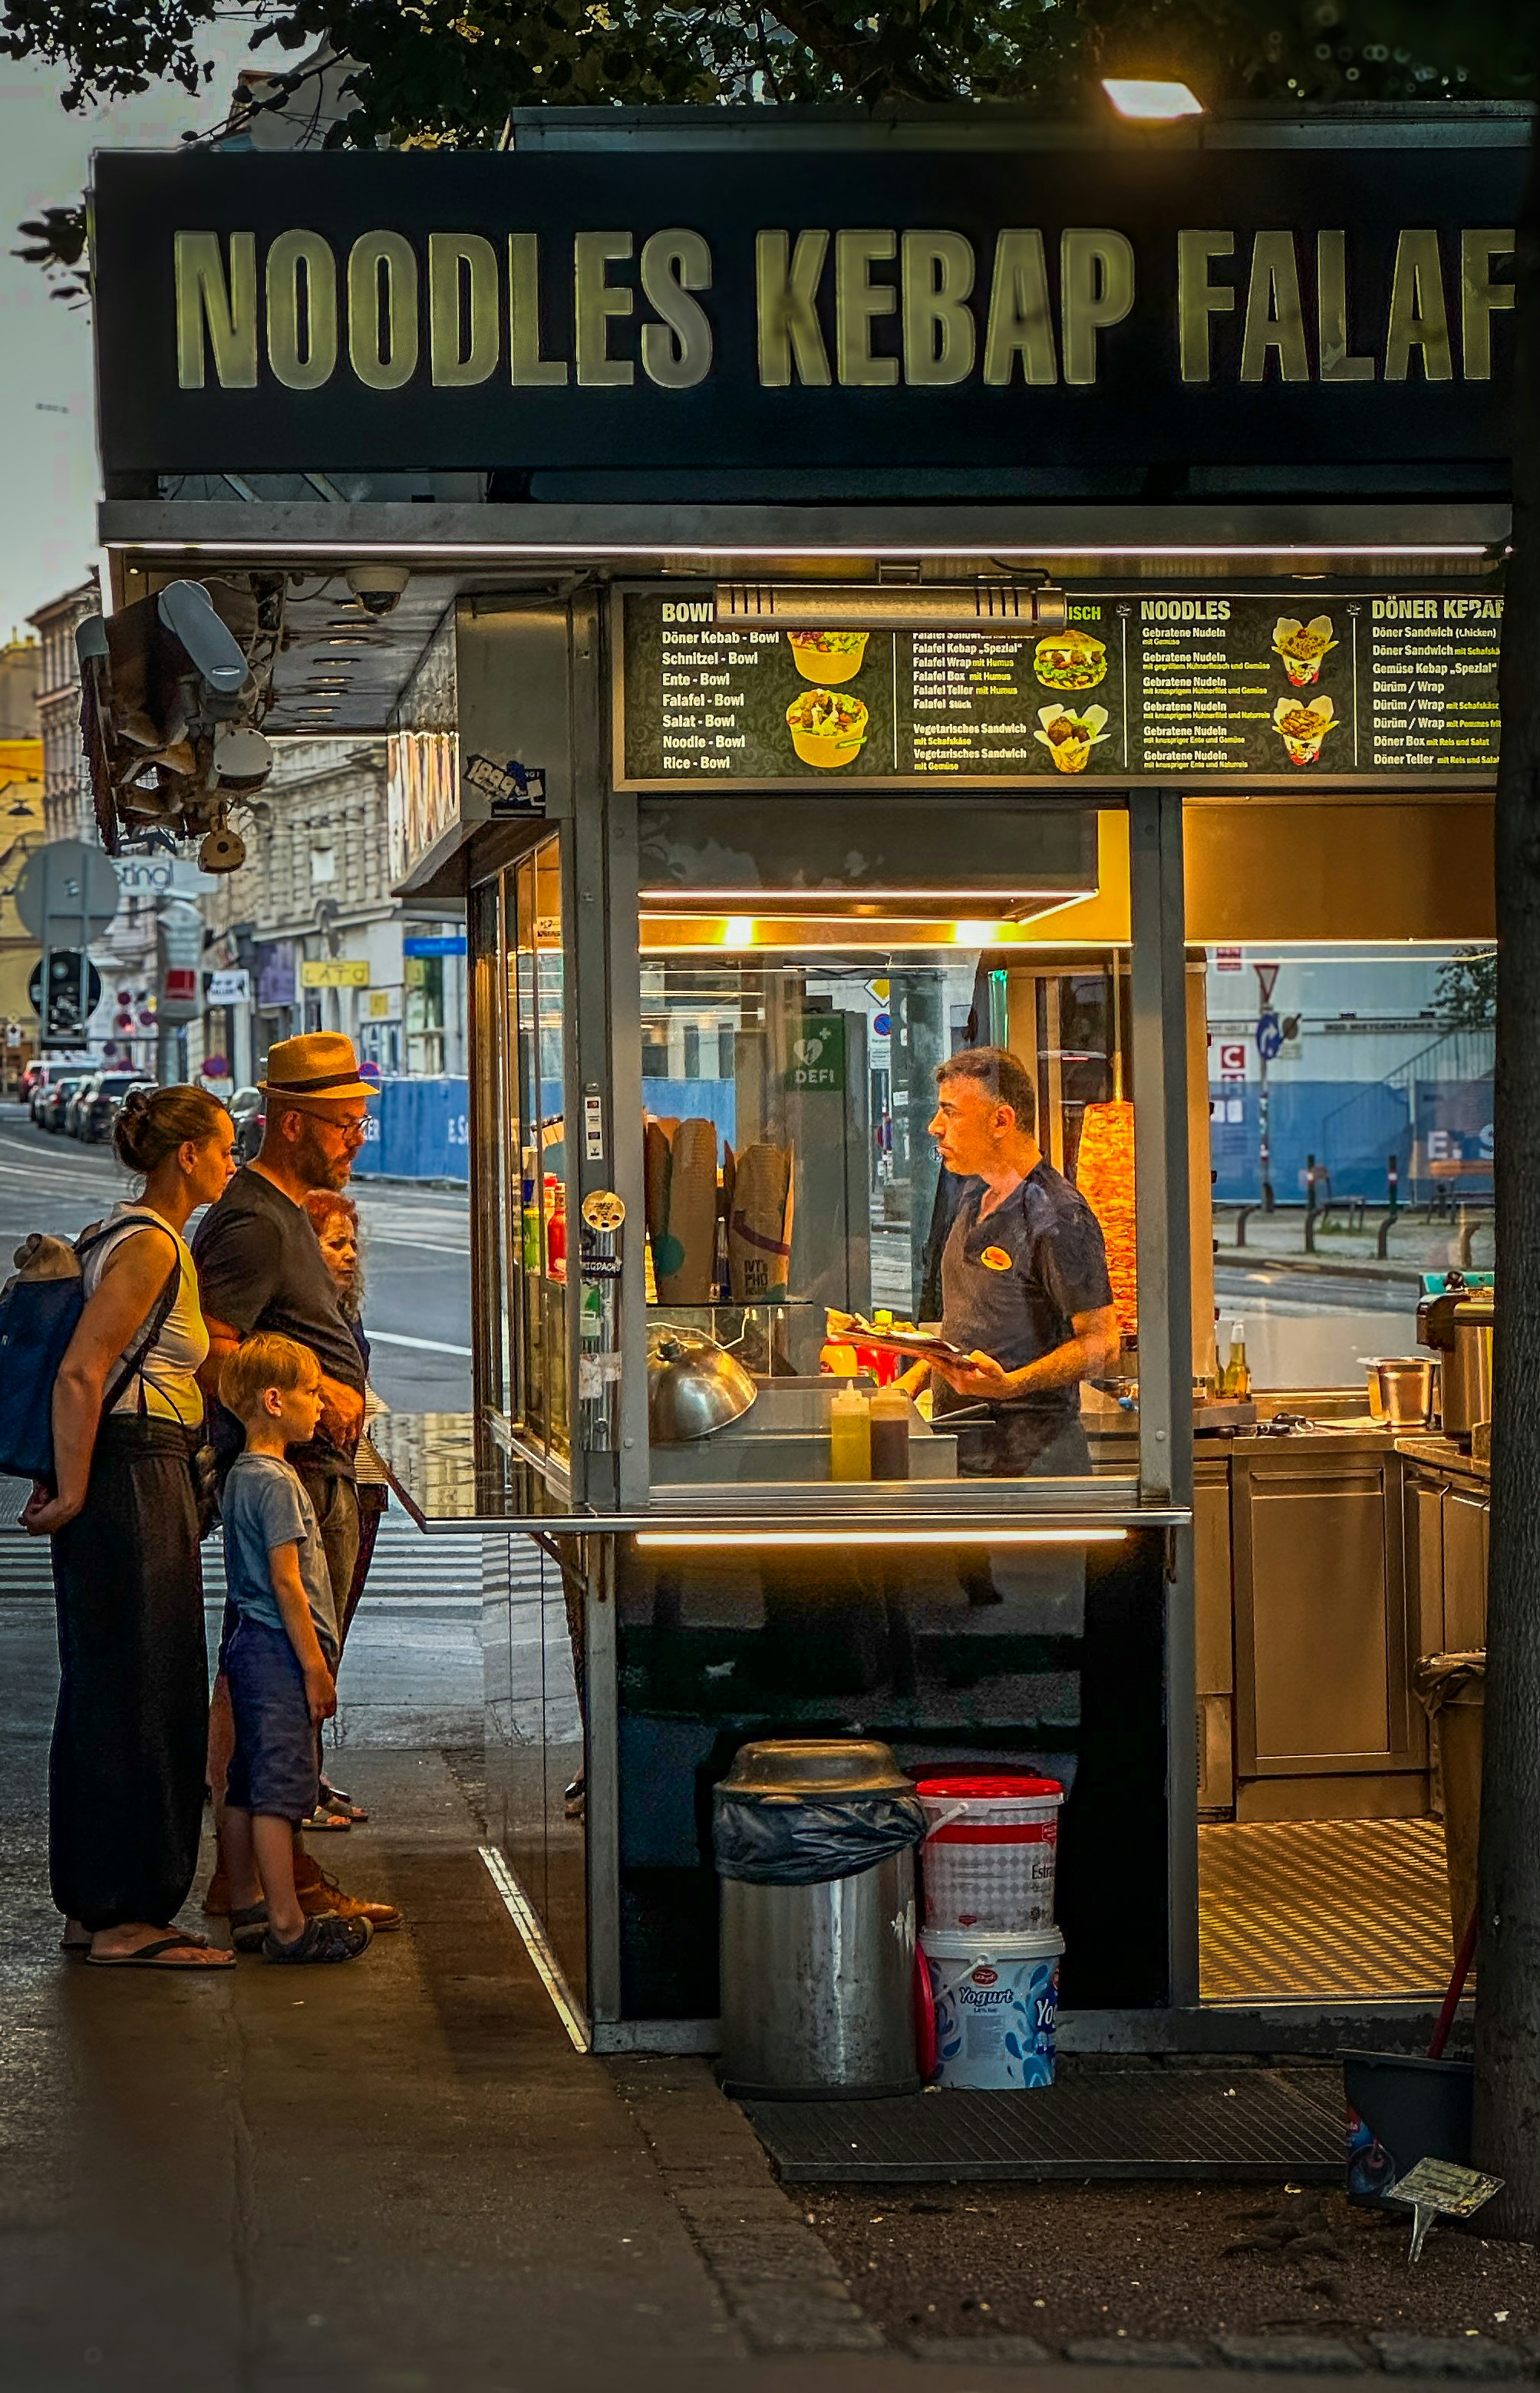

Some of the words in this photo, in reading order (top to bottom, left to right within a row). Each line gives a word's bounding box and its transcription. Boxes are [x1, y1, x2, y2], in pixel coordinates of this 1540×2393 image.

[174, 229, 714, 390] NOODLES
[755, 228, 1135, 386] KEBAP
[1140, 601, 1231, 620] NOODLES
[1372, 596, 1438, 619] DÖNER
[662, 631, 699, 644] Döner
[701, 631, 740, 644] Kebab
[750, 631, 779, 644] Bowl
[1142, 627, 1192, 638] Gebratene
[1192, 627, 1226, 638] Nudeln
[1372, 626, 1403, 638] Döner
[1404, 626, 1453, 638] Sandwich
[912, 642, 945, 653] Falafel
[947, 642, 977, 655] Kebap
[1372, 645, 1403, 655] Döner
[1404, 645, 1454, 655] Sandwich
[661, 652, 718, 665] Schnitzel
[729, 652, 758, 665] Bowl
[912, 657, 945, 667] Falafel
[947, 657, 972, 668] Wrap
[972, 658, 984, 667] mit
[1143, 652, 1192, 662] Gebratene
[1193, 652, 1226, 662] Nudeln
[1372, 662, 1414, 674] Gemüse
[1416, 662, 1448, 675] Kebap
[662, 672, 691, 686] Ente
[700, 672, 730, 686] Bowl
[913, 671, 945, 682] Falafel
[947, 671, 965, 682] Box
[969, 672, 982, 681] mit
[1143, 677, 1192, 687] Gebratene
[1193, 677, 1226, 687] Nudeln
[913, 685, 946, 695] Falafel
[947, 685, 974, 695] Teller
[975, 686, 989, 695] mit
[1373, 681, 1407, 692] Dürüm
[1408, 681, 1416, 694] /
[1417, 681, 1445, 694] Wrap
[662, 693, 705, 707] Falafel
[714, 693, 744, 707] Bowl
[913, 698, 946, 709] Falafel
[1143, 701, 1192, 711] Gebratene
[1193, 701, 1227, 711] Nudeln
[1373, 699, 1407, 711] Dürüm
[1408, 699, 1416, 712] /
[1417, 699, 1445, 712] Wrap
[662, 714, 696, 728] Salat
[705, 714, 735, 728] Bowl
[1373, 717, 1407, 728] Dürüm
[1408, 717, 1416, 730] /
[1417, 717, 1445, 730] Wrap
[913, 723, 980, 735] Vegetarisches
[981, 723, 1027, 734] Sandwich
[1143, 725, 1192, 736] Gebratene
[1194, 725, 1227, 736] Nudeln
[663, 735, 706, 748] Noodle
[715, 735, 745, 748] Bowl
[913, 737, 927, 745] mit
[1373, 735, 1405, 747] Döner
[1406, 735, 1426, 747] Box
[913, 748, 980, 761] Vegetarisches
[981, 748, 1027, 758] Sandwich
[1143, 750, 1192, 761] Gebratene
[1194, 750, 1228, 761] Nudeln
[1373, 754, 1404, 764] Döner
[1405, 754, 1434, 764] Teller
[663, 756, 691, 769] Rice
[701, 756, 730, 769] Bowl
[914, 762, 927, 771] mit
[795, 1068, 835, 1084] DEFI
[959, 1986, 1014, 2007] Yogurt
